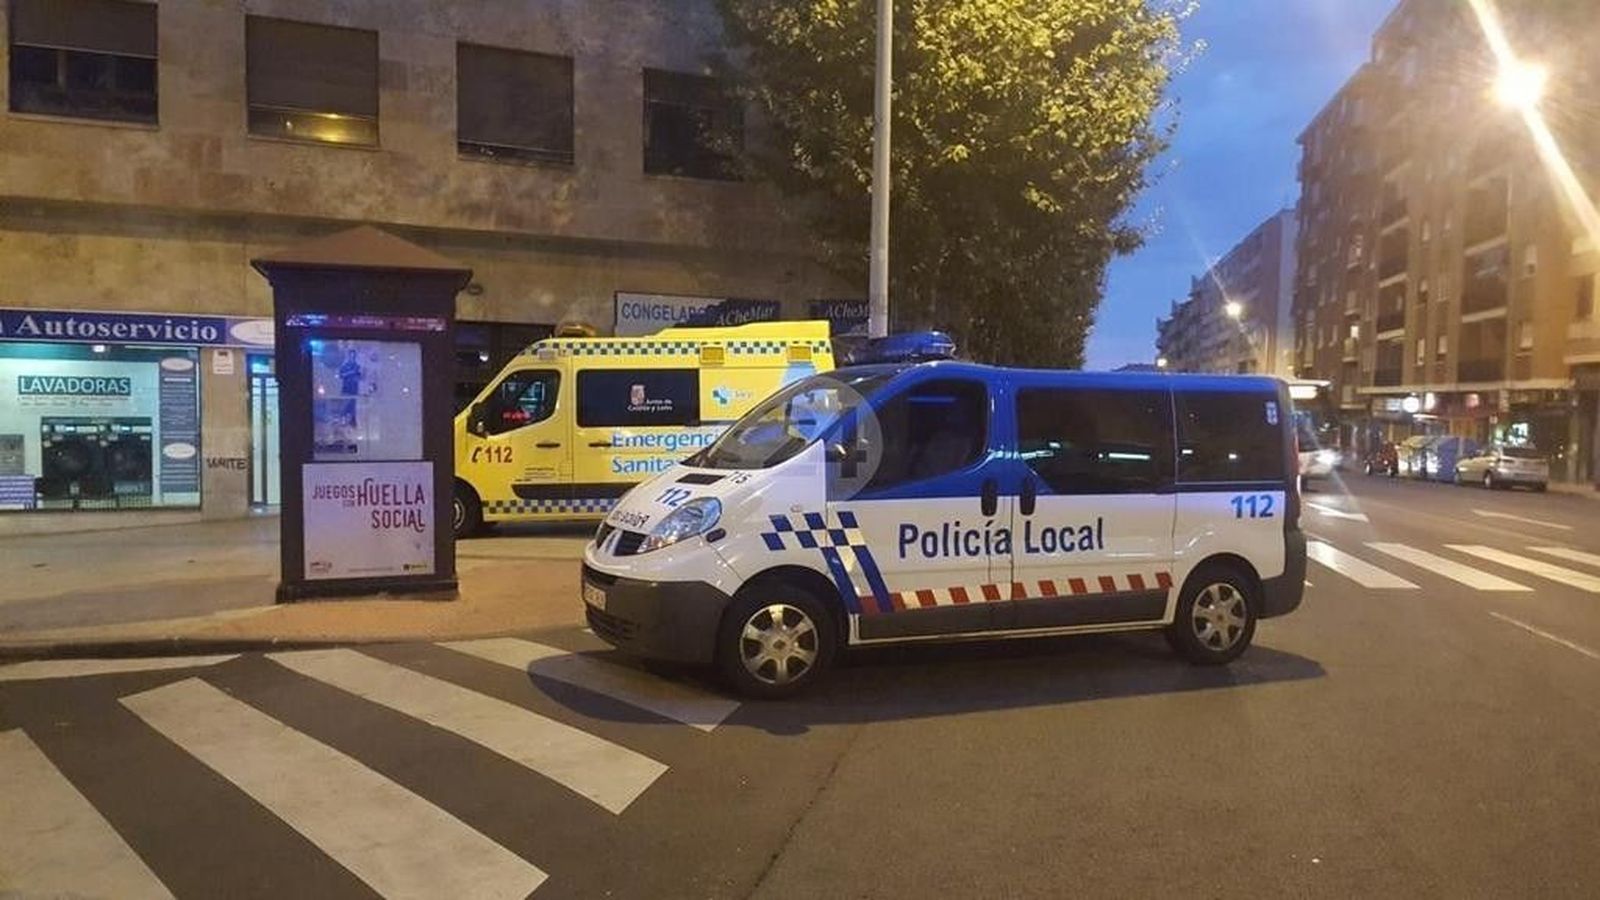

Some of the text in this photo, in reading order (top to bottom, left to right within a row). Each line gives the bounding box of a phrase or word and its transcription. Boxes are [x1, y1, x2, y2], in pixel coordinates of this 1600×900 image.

[16, 314, 218, 341] Autoservicio
[21, 378, 128, 394] LAVADORAS
[484, 446, 513, 463] 112
[612, 456, 675, 474] Sanita
[312, 485, 355, 499] JUEGOS
[357, 478, 425, 506] HUELLA
[655, 487, 691, 507] 112
[1231, 494, 1275, 518] 112
[371, 509, 425, 533] SOCIAL
[899, 517, 1104, 559] Policía Local
